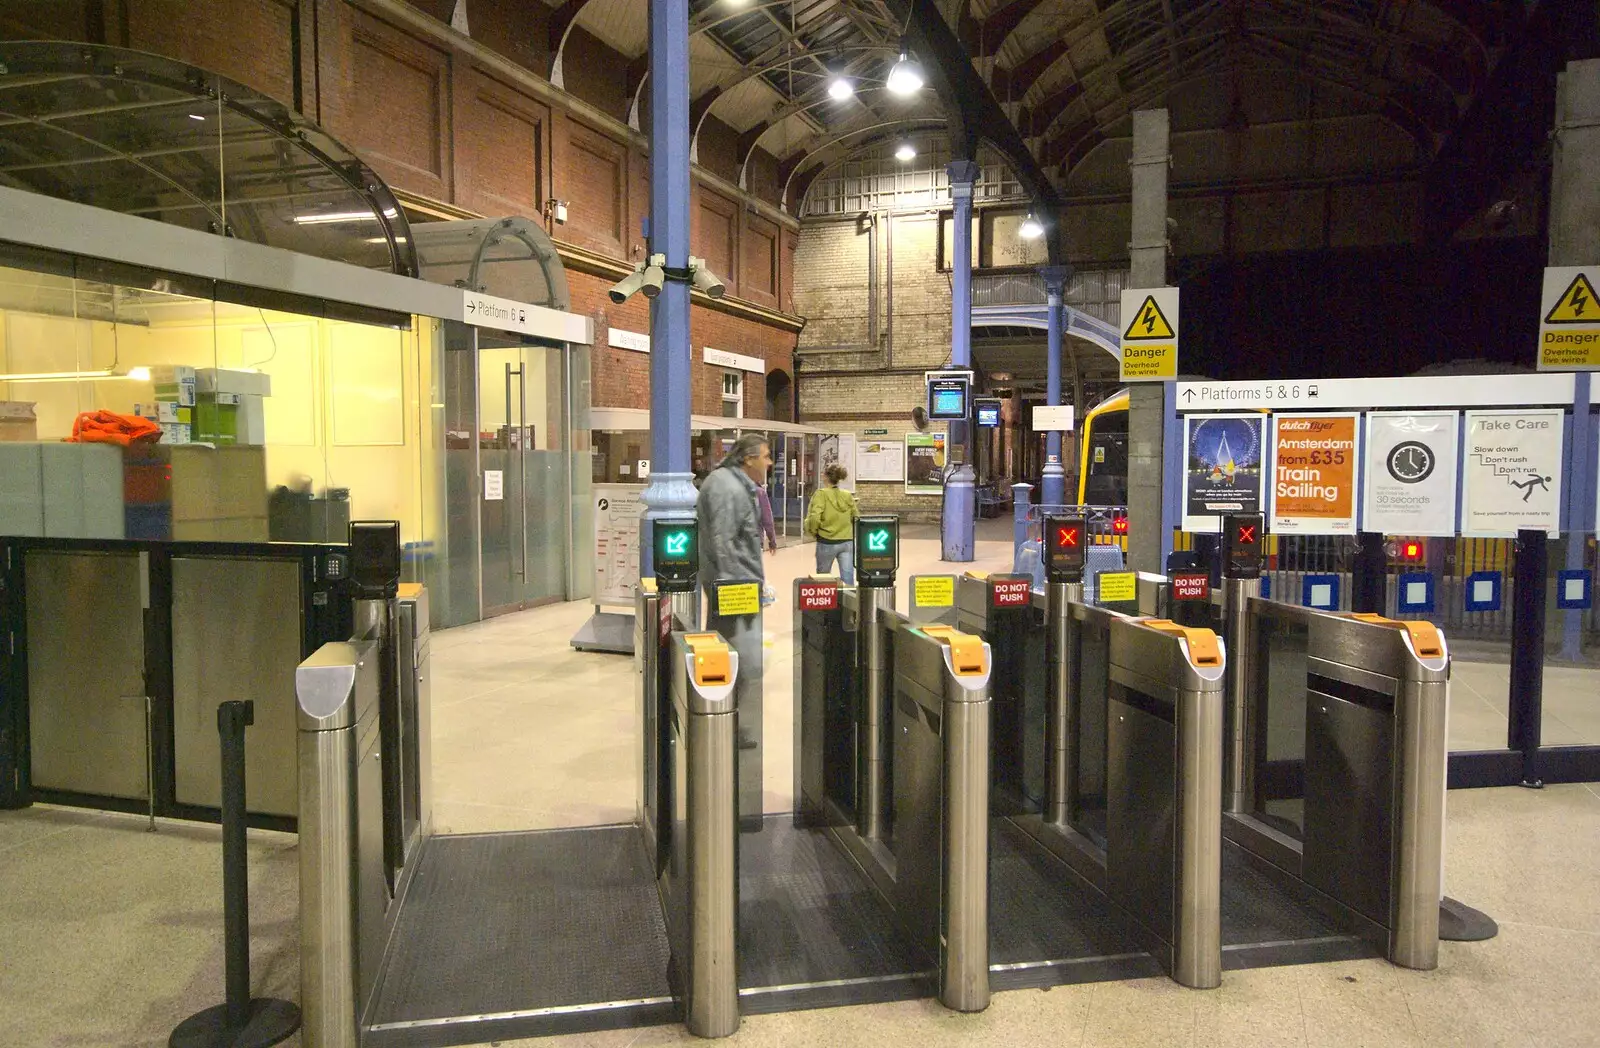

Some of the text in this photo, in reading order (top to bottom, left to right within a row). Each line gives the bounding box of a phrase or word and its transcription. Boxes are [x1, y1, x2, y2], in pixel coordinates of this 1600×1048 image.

[478, 301, 516, 320] Platform 6
[1545, 333, 1600, 344] Danger
[1124, 348, 1166, 358] Danger
[1201, 385, 1300, 400] Platforms 5 & 6
[1479, 420, 1549, 430] Take Care
[1278, 439, 1354, 449] Amsterdam
[1278, 450, 1344, 465] from £35
[1278, 466, 1320, 481] Train
[1277, 483, 1338, 501] Sailing
[1390, 496, 1430, 504] seconds
[801, 588, 836, 596] DO NOT
[1010, 584, 1027, 592] NOT
[806, 597, 831, 605] PUSH
